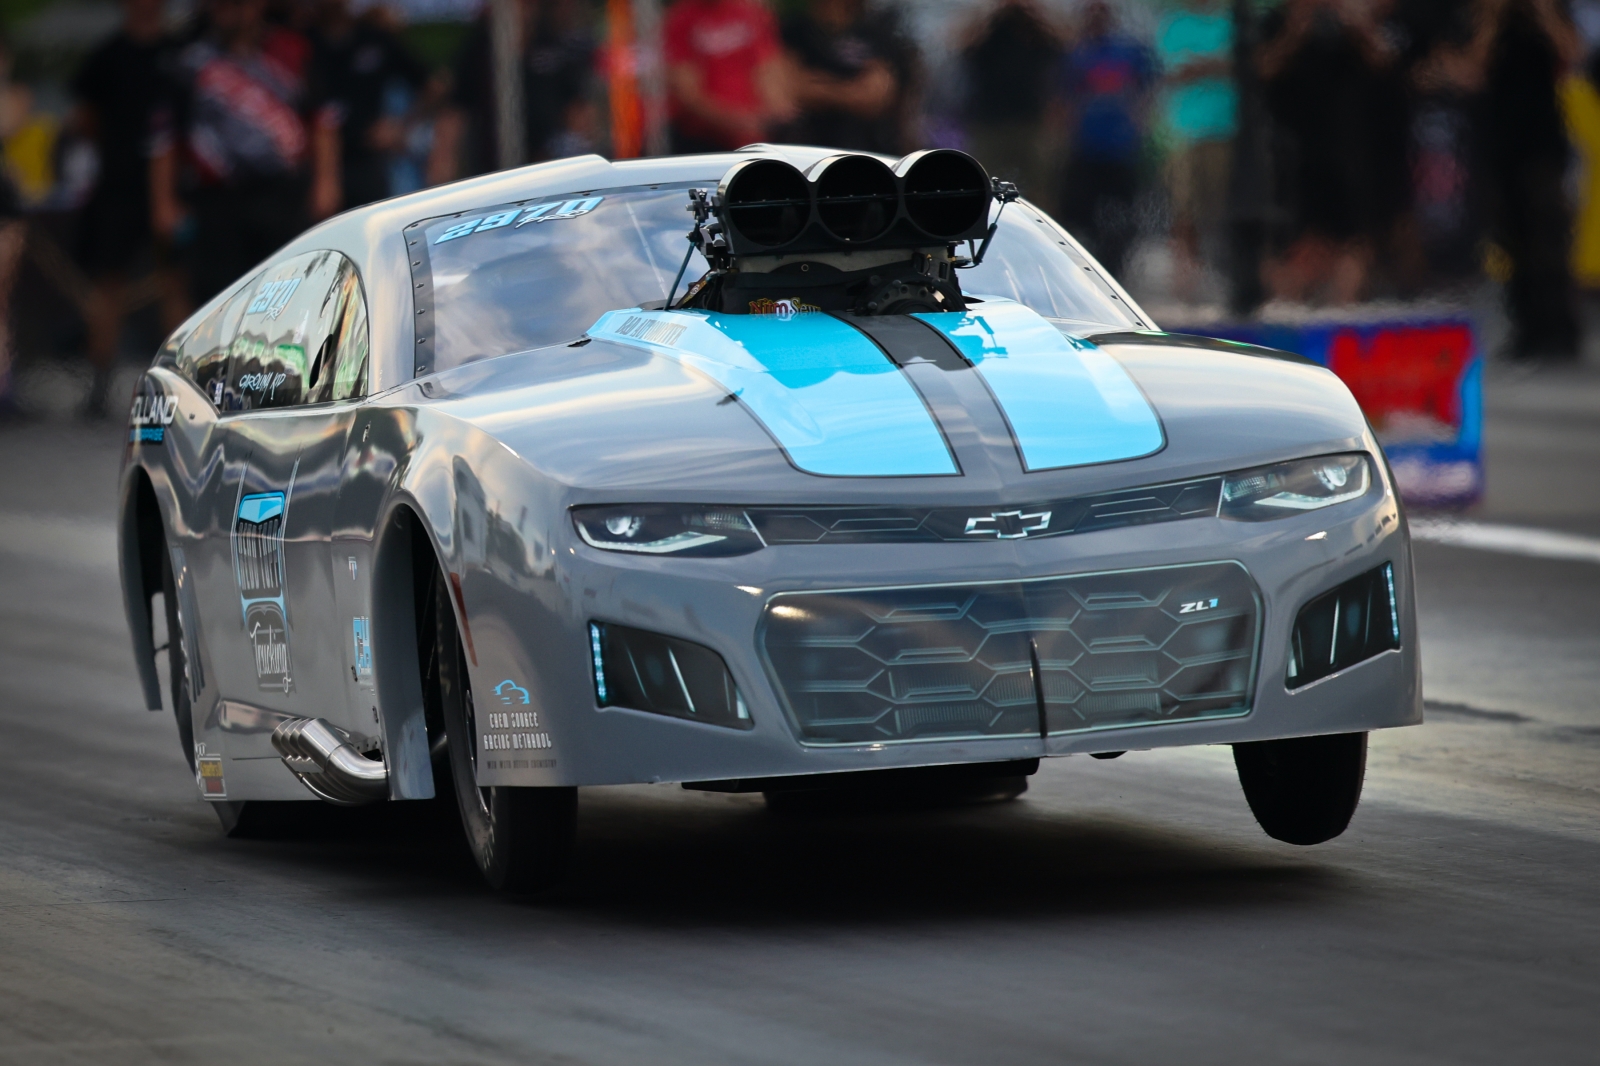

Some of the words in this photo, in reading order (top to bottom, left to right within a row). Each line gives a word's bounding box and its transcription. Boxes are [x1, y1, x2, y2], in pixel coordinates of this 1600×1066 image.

[434, 196, 604, 245] 2970
[247, 277, 302, 315] 2970
[1179, 598, 1219, 614] ZL1
[249, 621, 291, 693] Trucking
[489, 712, 509, 728] CHEM
[511, 711, 539, 728] SOURCE
[483, 733, 510, 750] RACING
[512, 732, 552, 749] METHANOL
